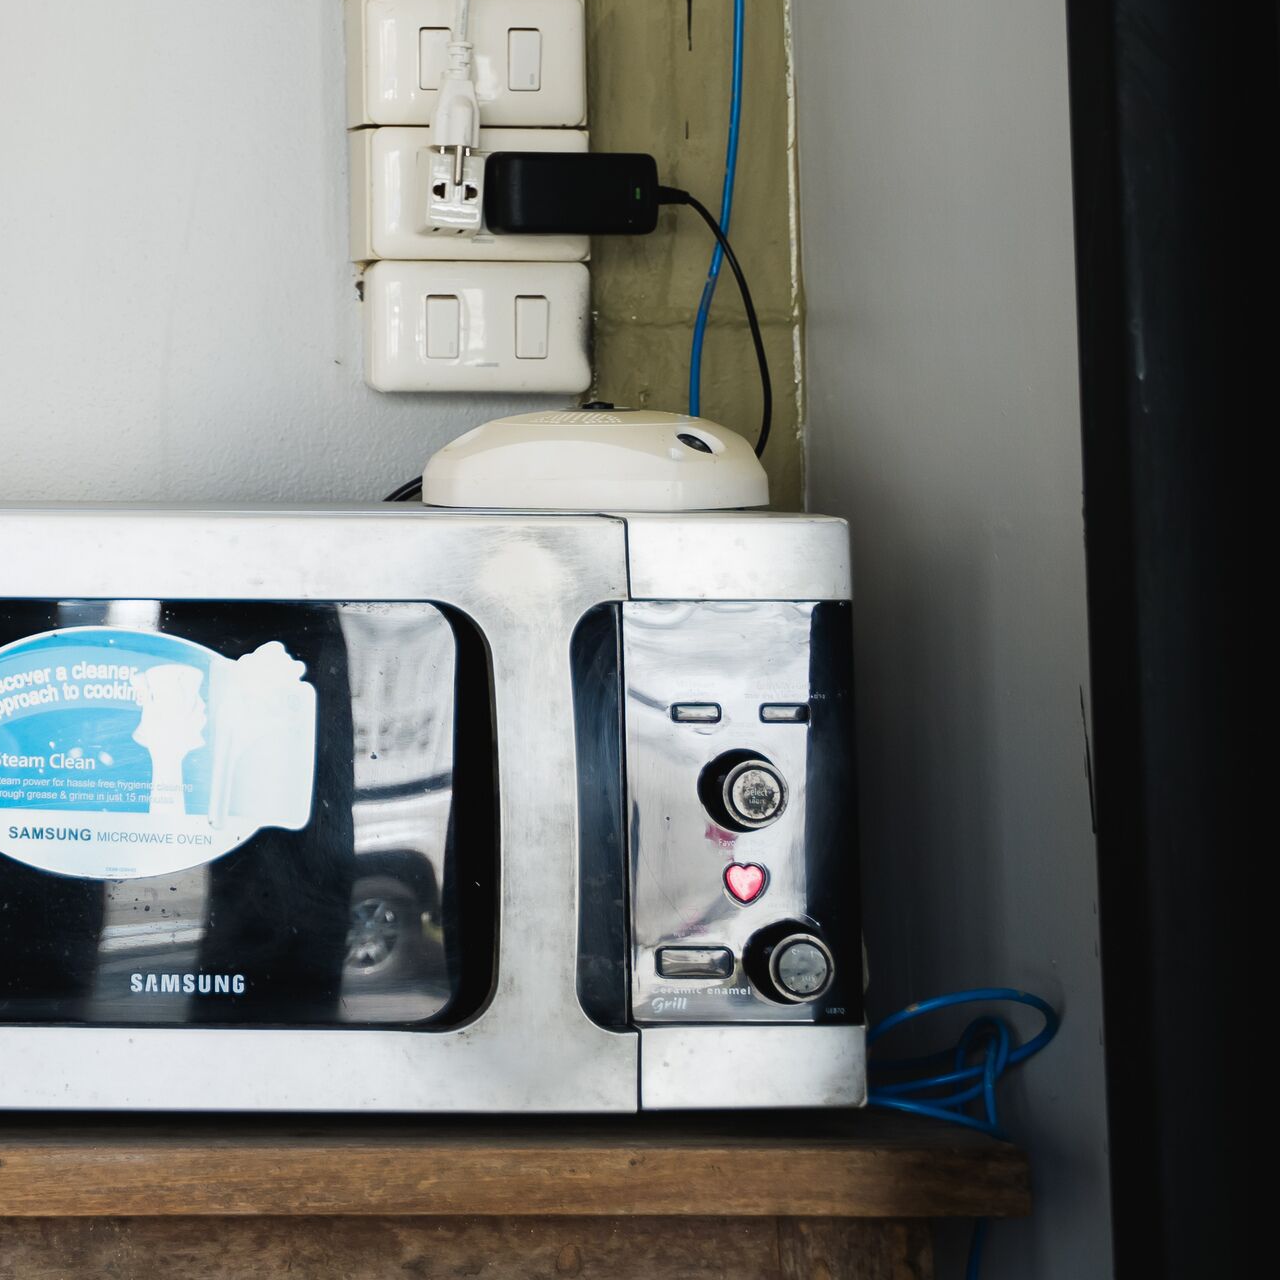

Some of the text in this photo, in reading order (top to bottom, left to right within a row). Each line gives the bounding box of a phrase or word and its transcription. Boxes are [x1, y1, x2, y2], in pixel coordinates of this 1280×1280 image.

[55, 665, 68, 681] a
[71, 661, 138, 681] cleaner
[63, 683, 80, 701] to
[83, 681, 146, 707] cooking
[49, 752, 96, 770] Clean
[22, 778, 50, 788] power
[52, 777, 64, 787] for
[66, 778, 96, 788] hassle
[97, 779, 115, 789] free
[117, 780, 153, 792] hygienic
[27, 791, 58, 801] grease
[60, 791, 67, 800] &
[69, 792, 94, 802] grime
[96, 793, 104, 802] in
[106, 793, 124, 804] just
[126, 793, 136, 803] 15
[8, 826, 213, 845] SAMSUNG MICROWAVE OVEN
[130, 973, 245, 994] SAMSUNG
[706, 986, 751, 995] enamel
[651, 997, 688, 1014] Grill
